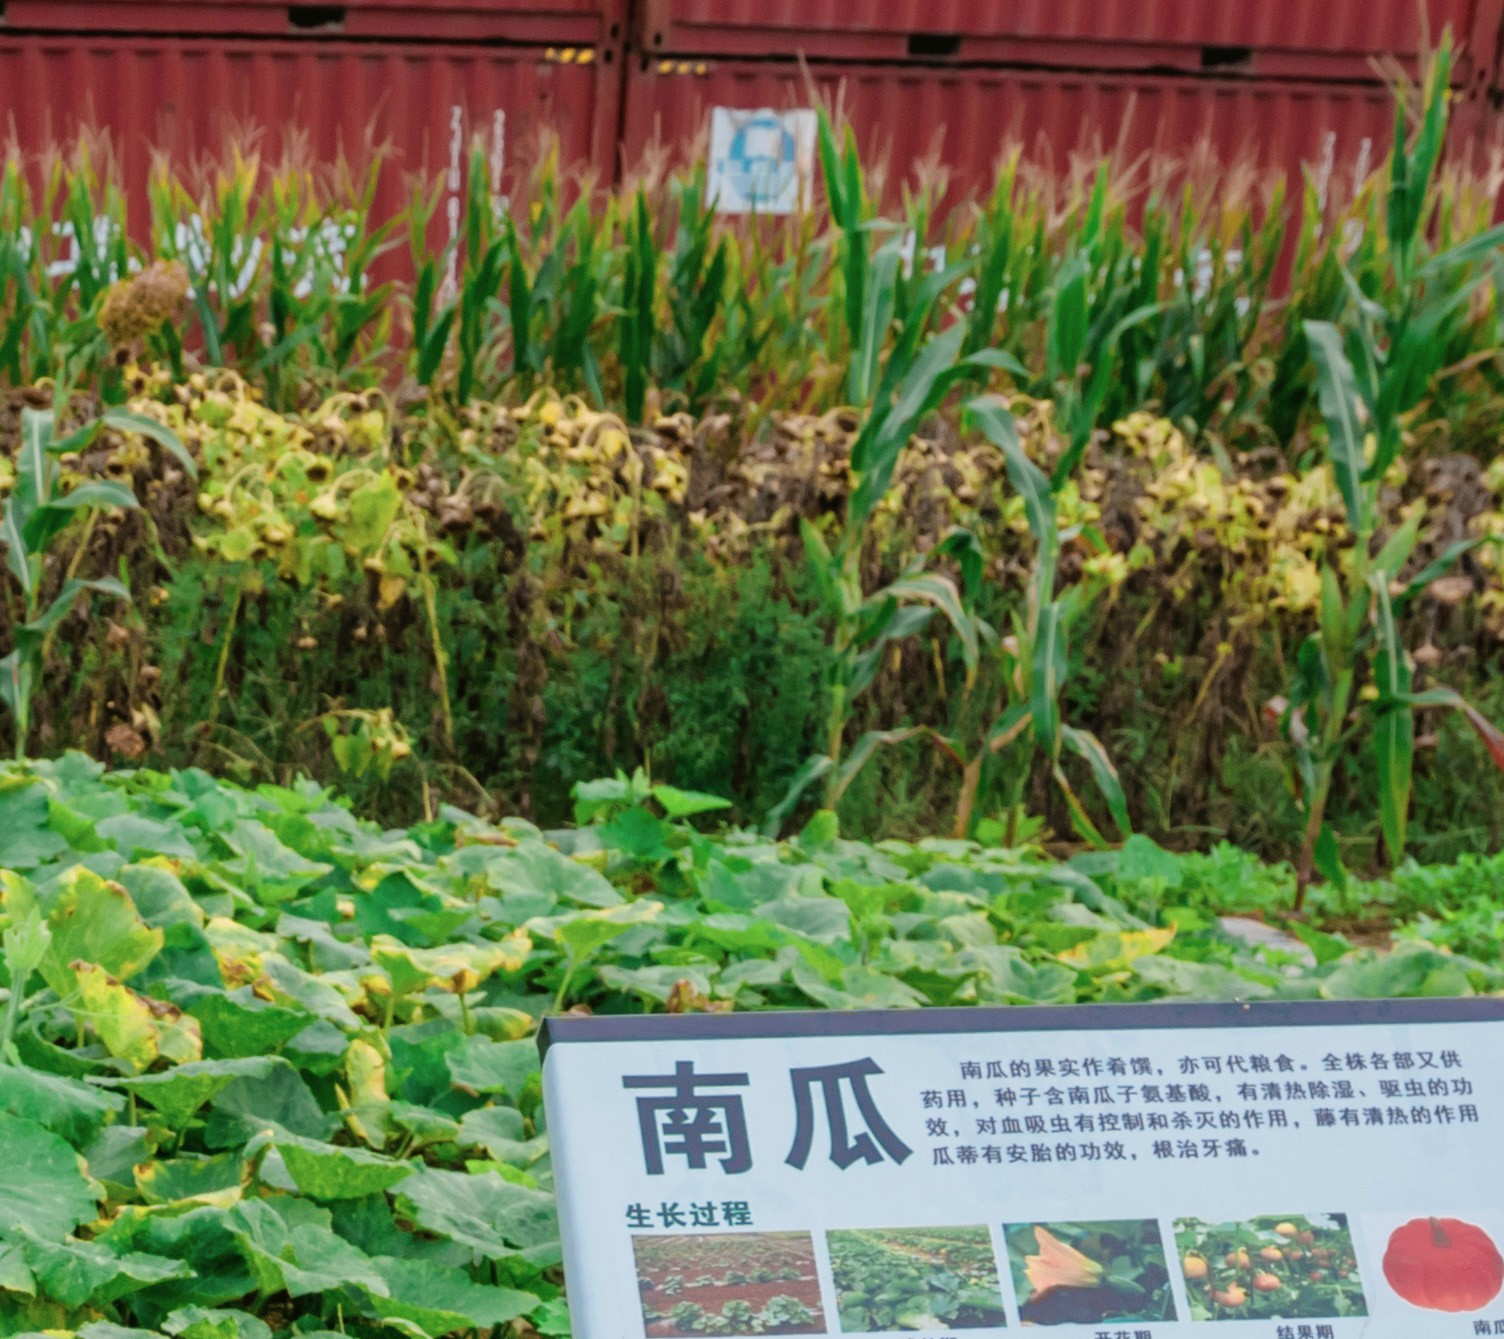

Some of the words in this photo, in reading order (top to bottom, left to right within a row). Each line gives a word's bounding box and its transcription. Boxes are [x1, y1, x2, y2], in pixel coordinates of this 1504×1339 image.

[622, 1057, 913, 1175] 南瓜
[933, 1138, 1260, 1165] 瓜蒂有安胎的功效，根治牙痛。
[625, 1200, 753, 1228] 生长过程
